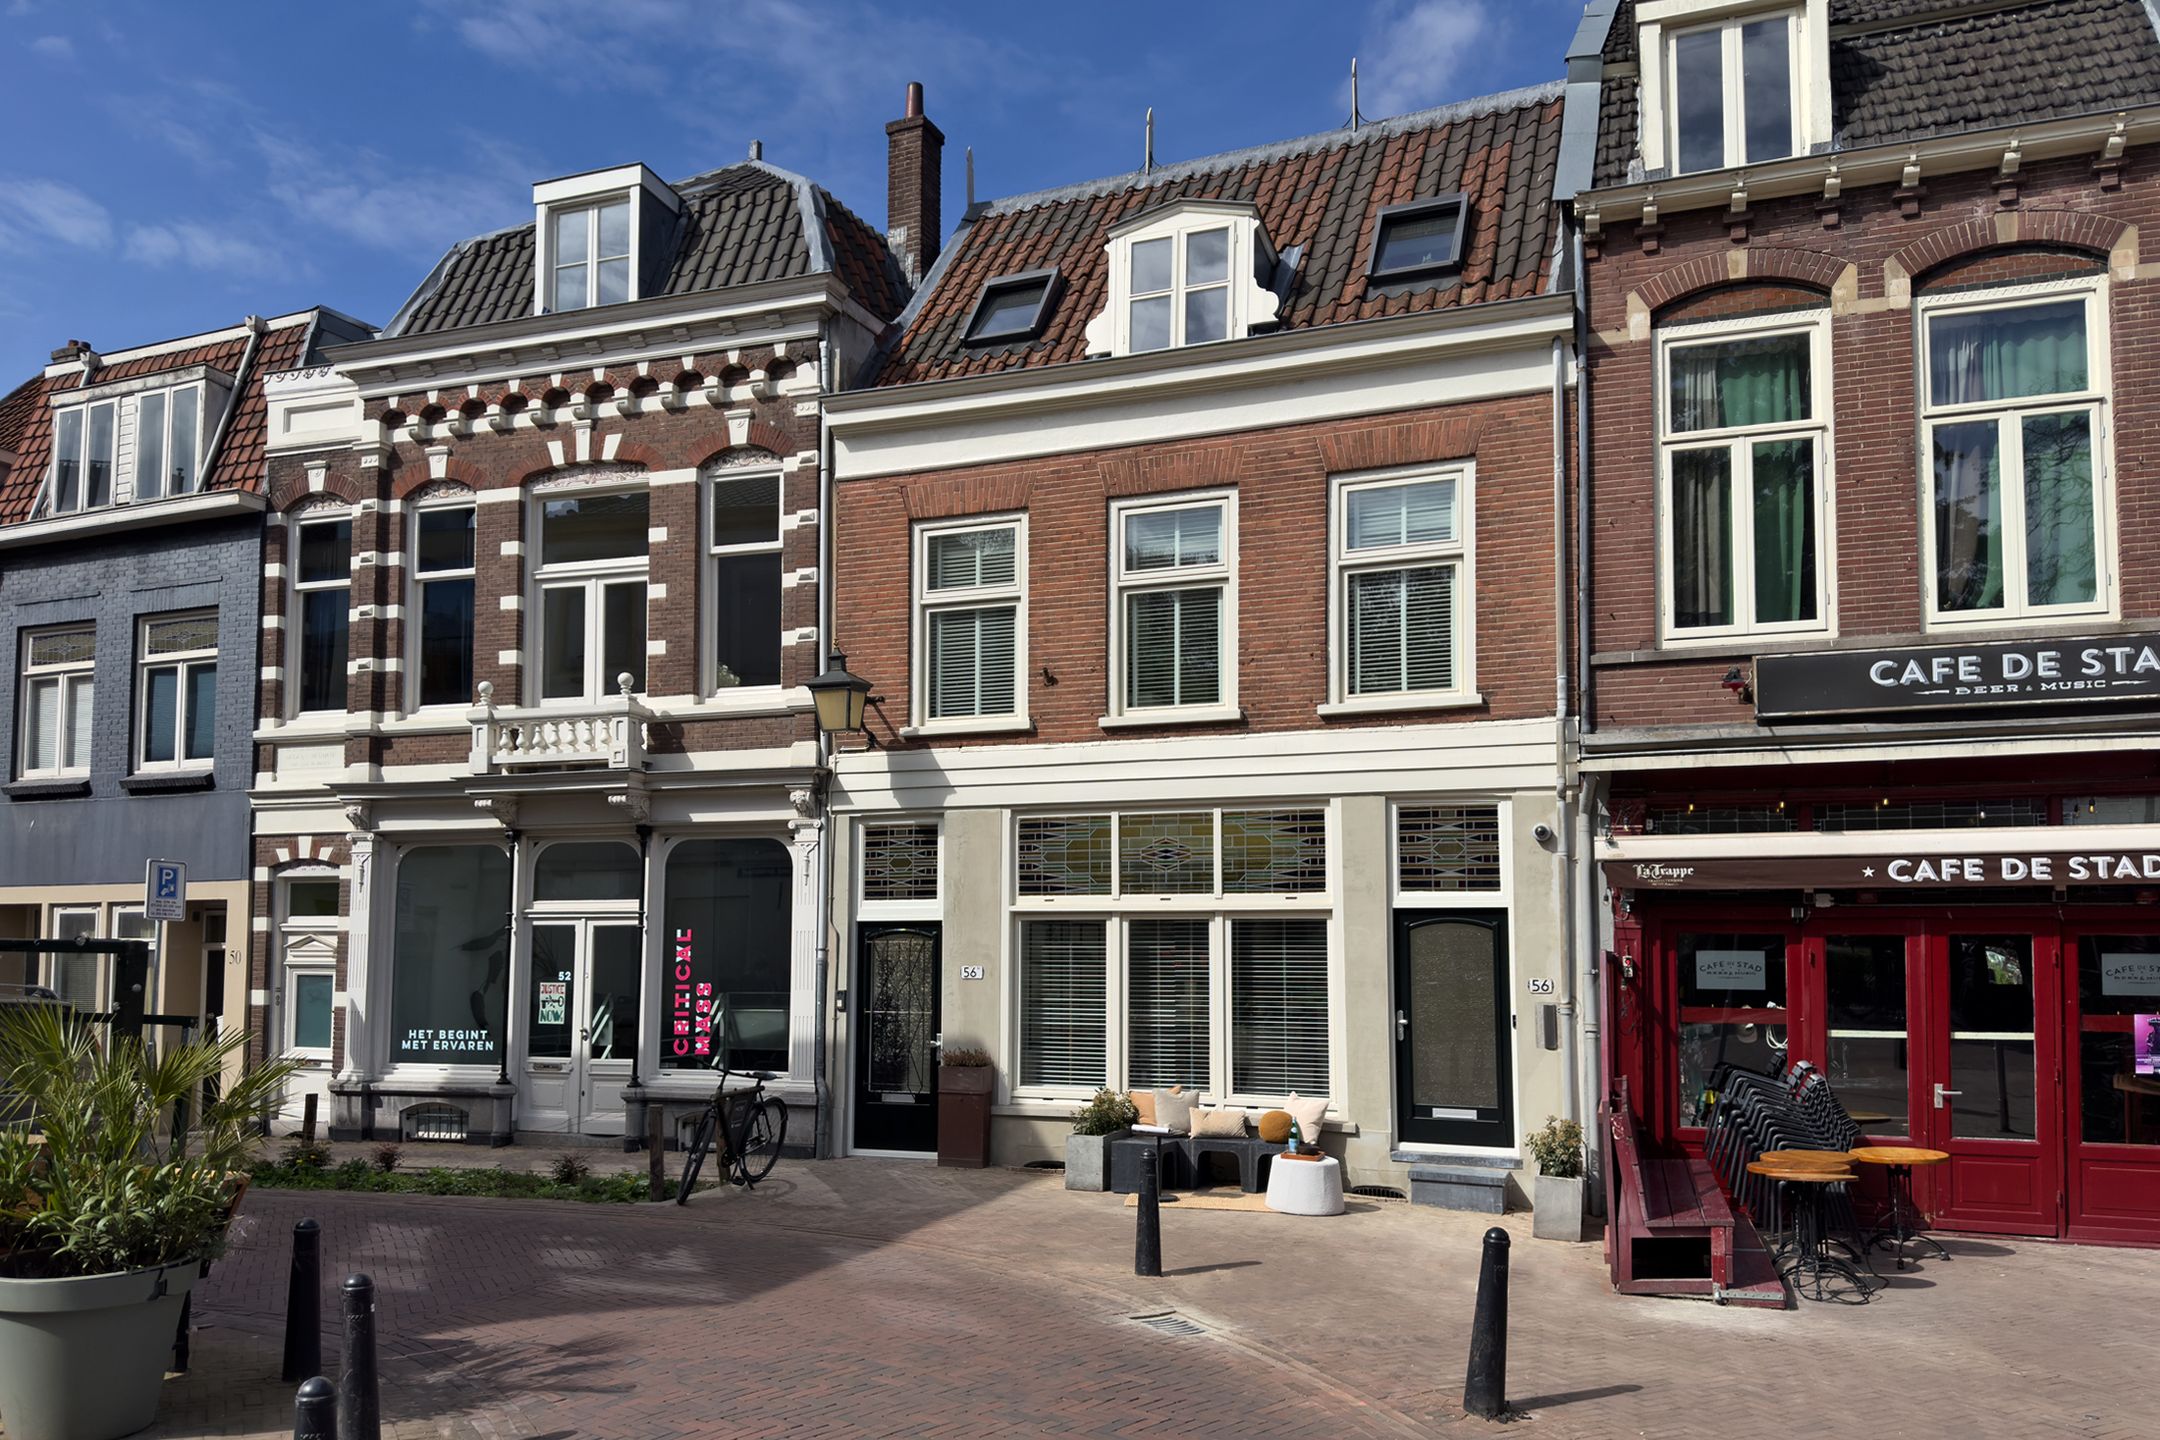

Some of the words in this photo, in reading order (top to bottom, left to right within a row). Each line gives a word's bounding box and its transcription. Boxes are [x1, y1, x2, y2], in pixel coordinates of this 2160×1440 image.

[1869, 655, 1982, 687] CAFE
[2002, 650, 2061, 680] DE
[1955, 684, 2019, 695] BEER
[2040, 680, 2106, 691] MUSIC
[1649, 863, 1695, 880] Trappe
[1887, 858, 1985, 882] CAFE
[2001, 857, 2052, 881] DE
[229, 950, 242, 965] 50
[558, 971, 572, 981] 52
[673, 929, 692, 1056] CRITICAL
[1532, 979, 1550, 992] 56
[695, 982, 712, 1056] MASS
[408, 1029, 434, 1039] HET
[439, 1029, 488, 1040] BEGINT
[401, 1040, 428, 1050] MET
[433, 1040, 494, 1051] ERVAREN
